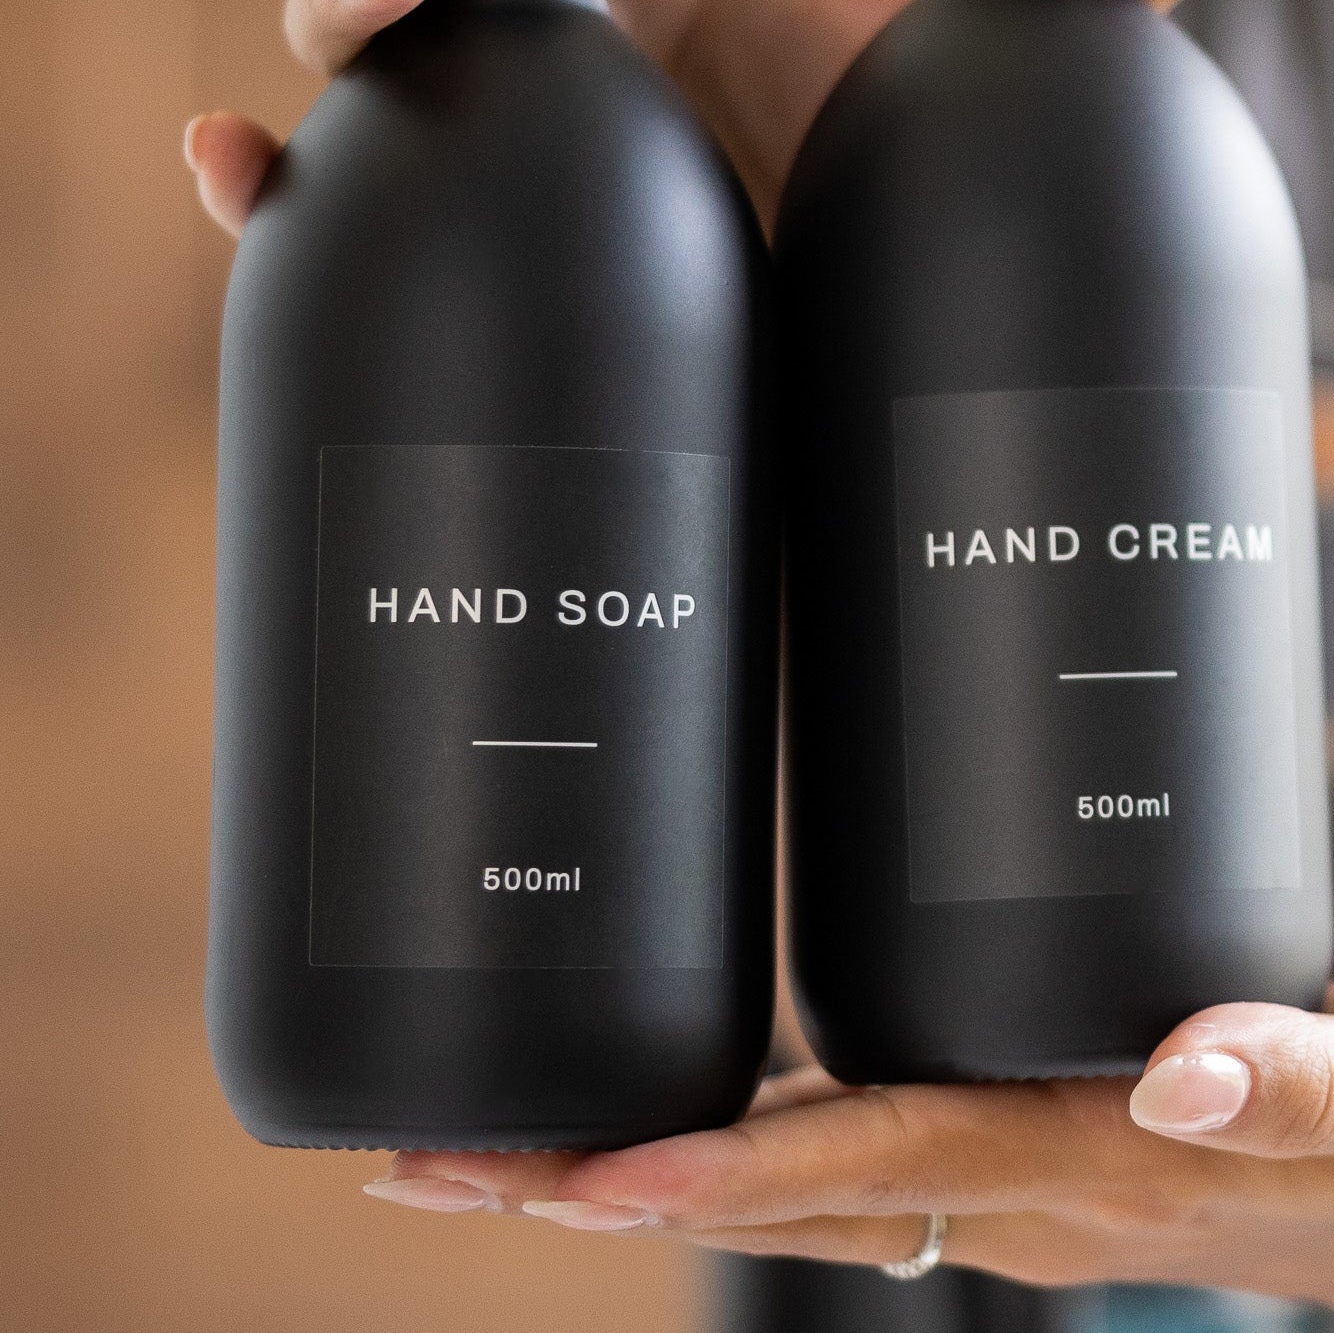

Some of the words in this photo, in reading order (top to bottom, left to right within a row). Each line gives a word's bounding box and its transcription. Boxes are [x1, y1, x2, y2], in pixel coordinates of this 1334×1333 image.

[925, 526, 1081, 569] HAND
[1107, 522, 1274, 564] CREAM
[368, 587, 528, 624] HAND
[557, 589, 697, 629] SOAP
[1077, 792, 1170, 820] 500ml
[482, 866, 581, 893] 500ml
